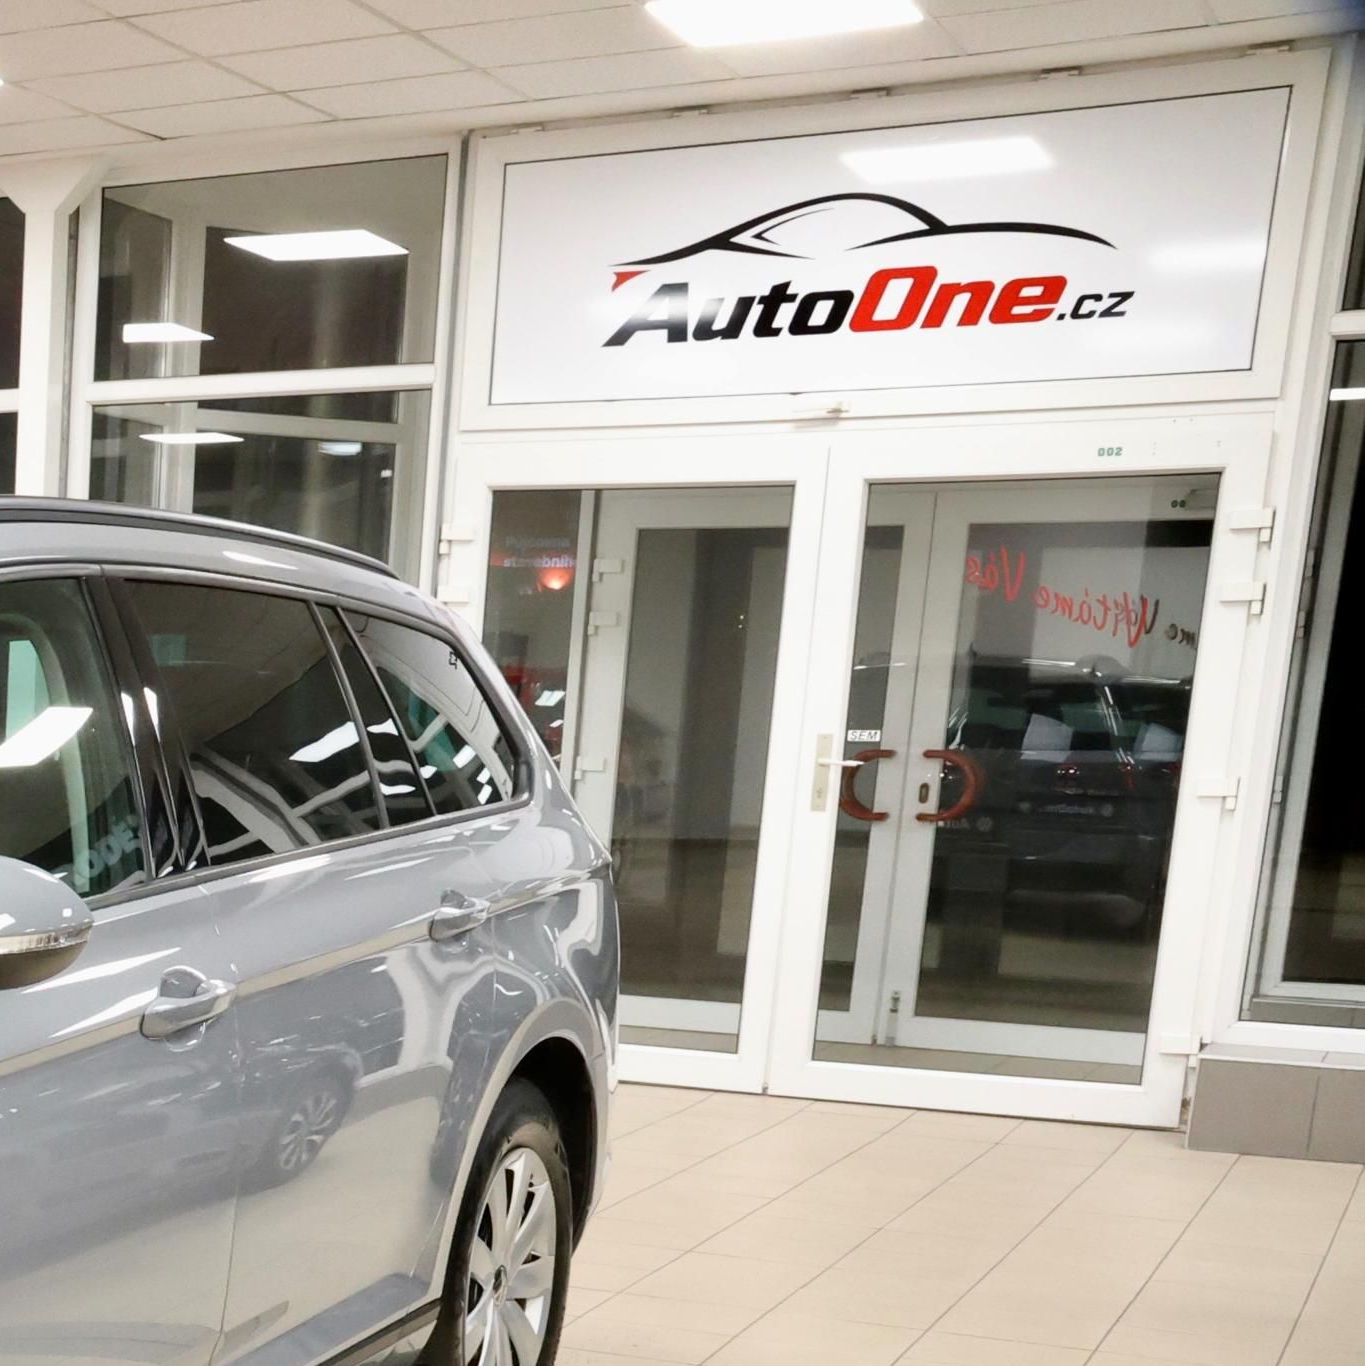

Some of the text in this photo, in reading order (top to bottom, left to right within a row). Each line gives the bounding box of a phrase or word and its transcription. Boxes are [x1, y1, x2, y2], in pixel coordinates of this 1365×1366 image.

[602, 265, 1135, 347] AutoOne.cz
[1097, 446, 1124, 457] 002
[849, 730, 879, 741] SEM
